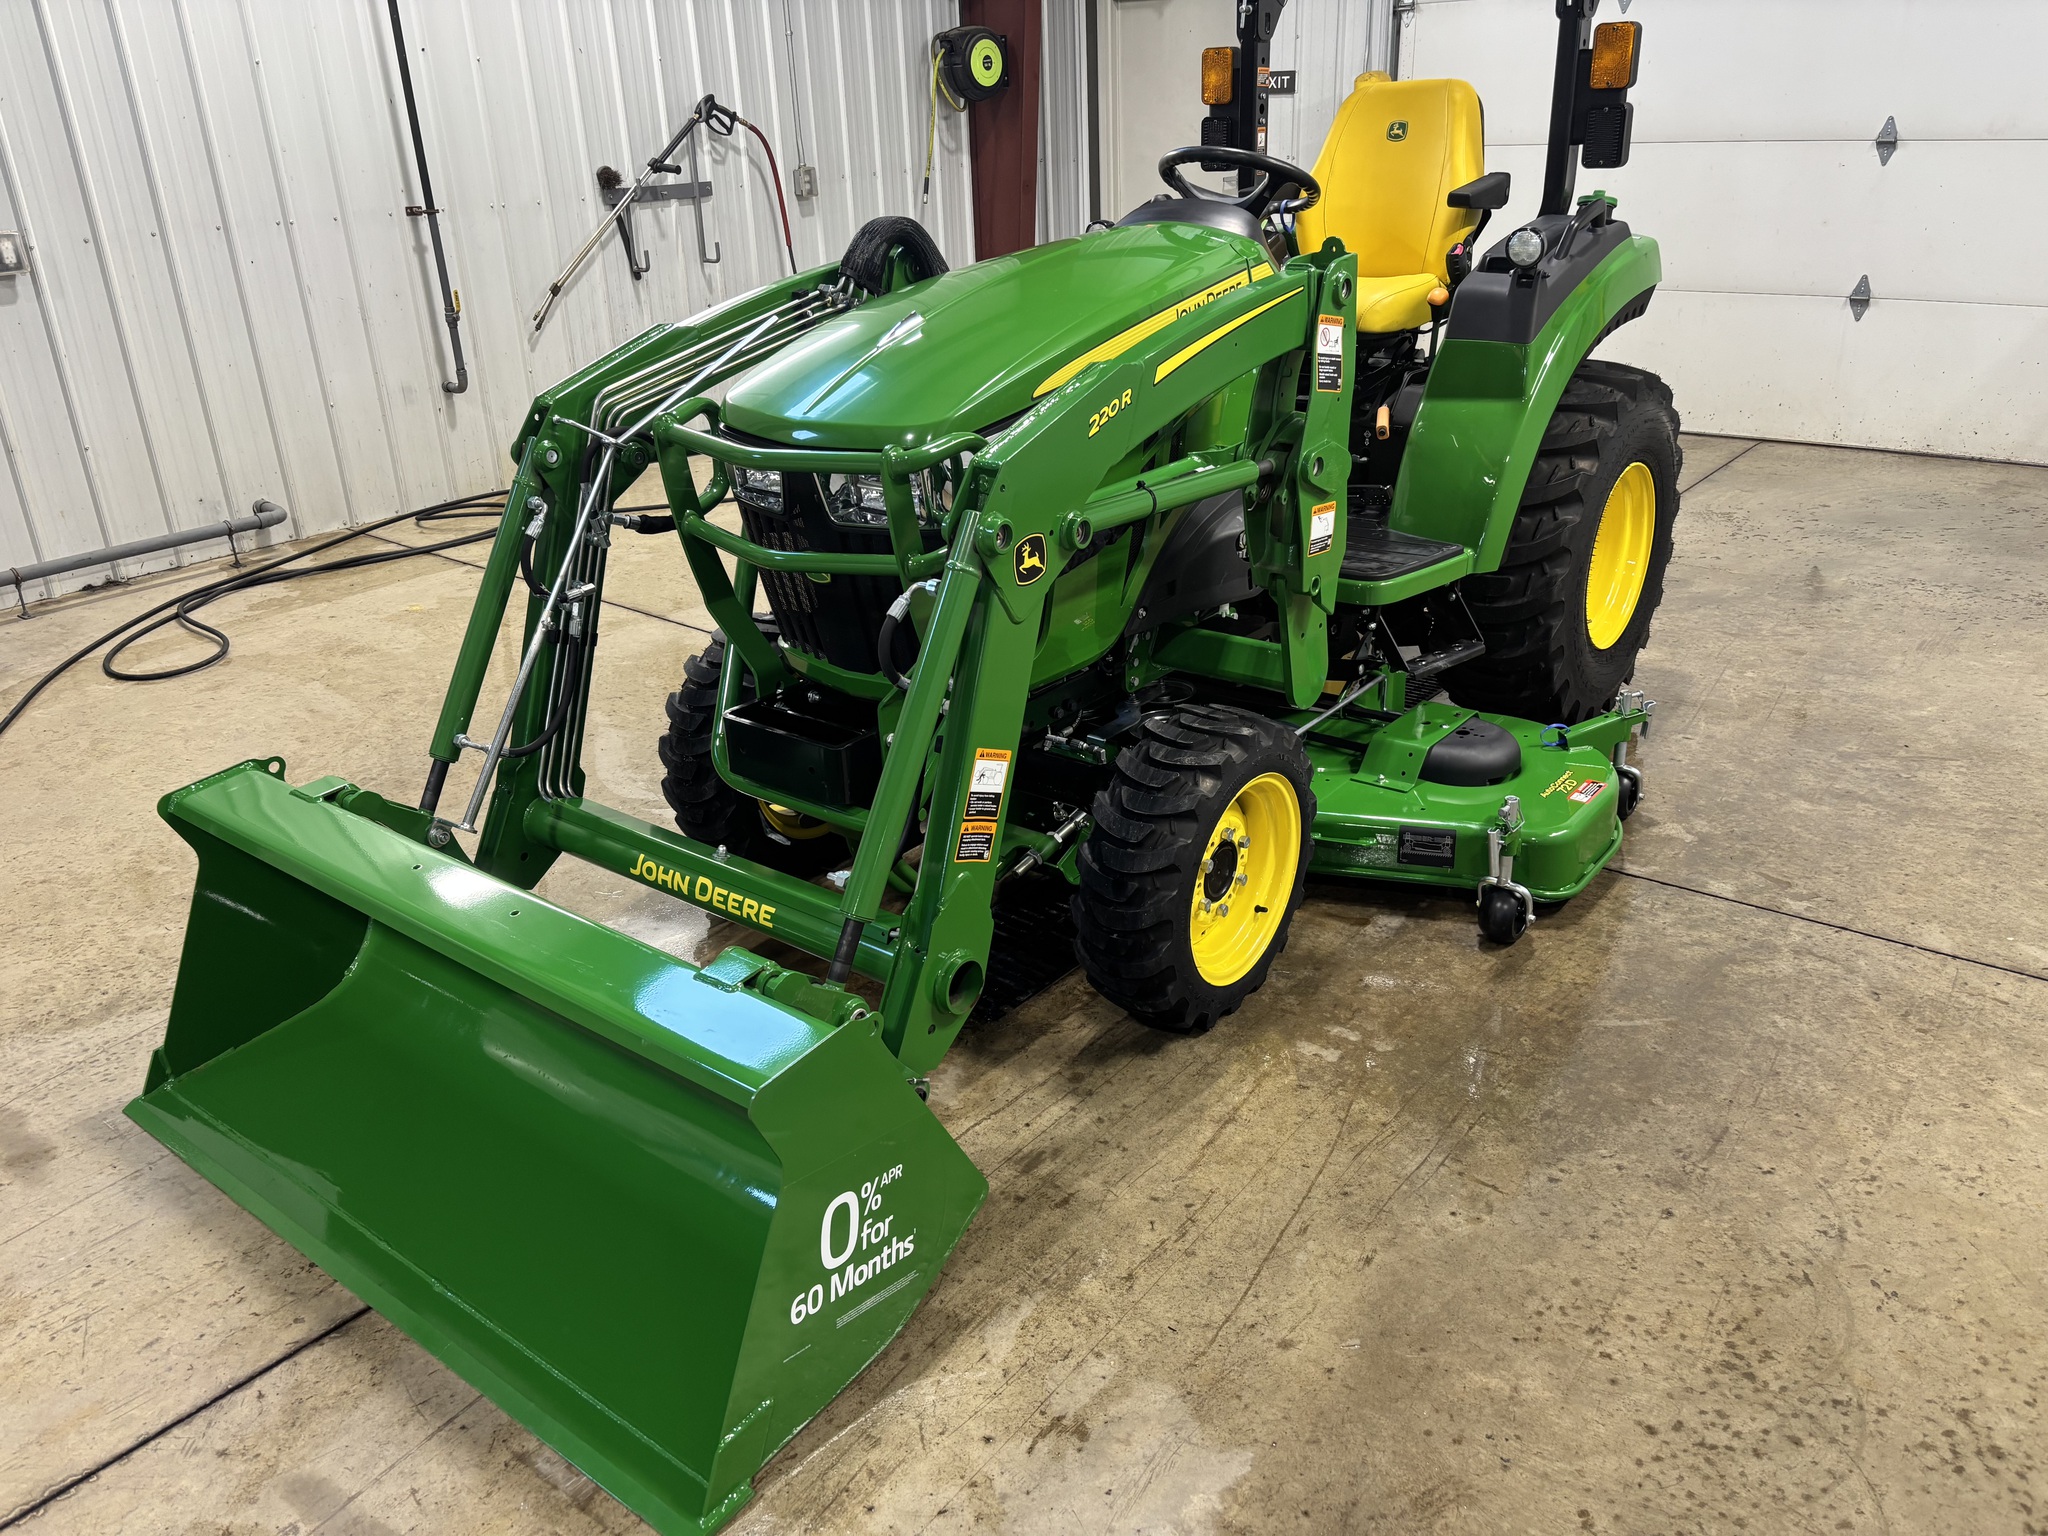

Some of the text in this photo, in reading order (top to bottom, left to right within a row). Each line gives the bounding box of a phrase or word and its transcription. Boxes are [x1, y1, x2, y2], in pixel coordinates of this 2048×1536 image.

[1268, 75, 1290, 89] XIT
[1556, 779, 1578, 794] 72D
[630, 853, 776, 929] JOHN DEERE
[880, 1164, 903, 1188] APR
[860, 1215, 894, 1250] for
[790, 1283, 824, 1325] 60
